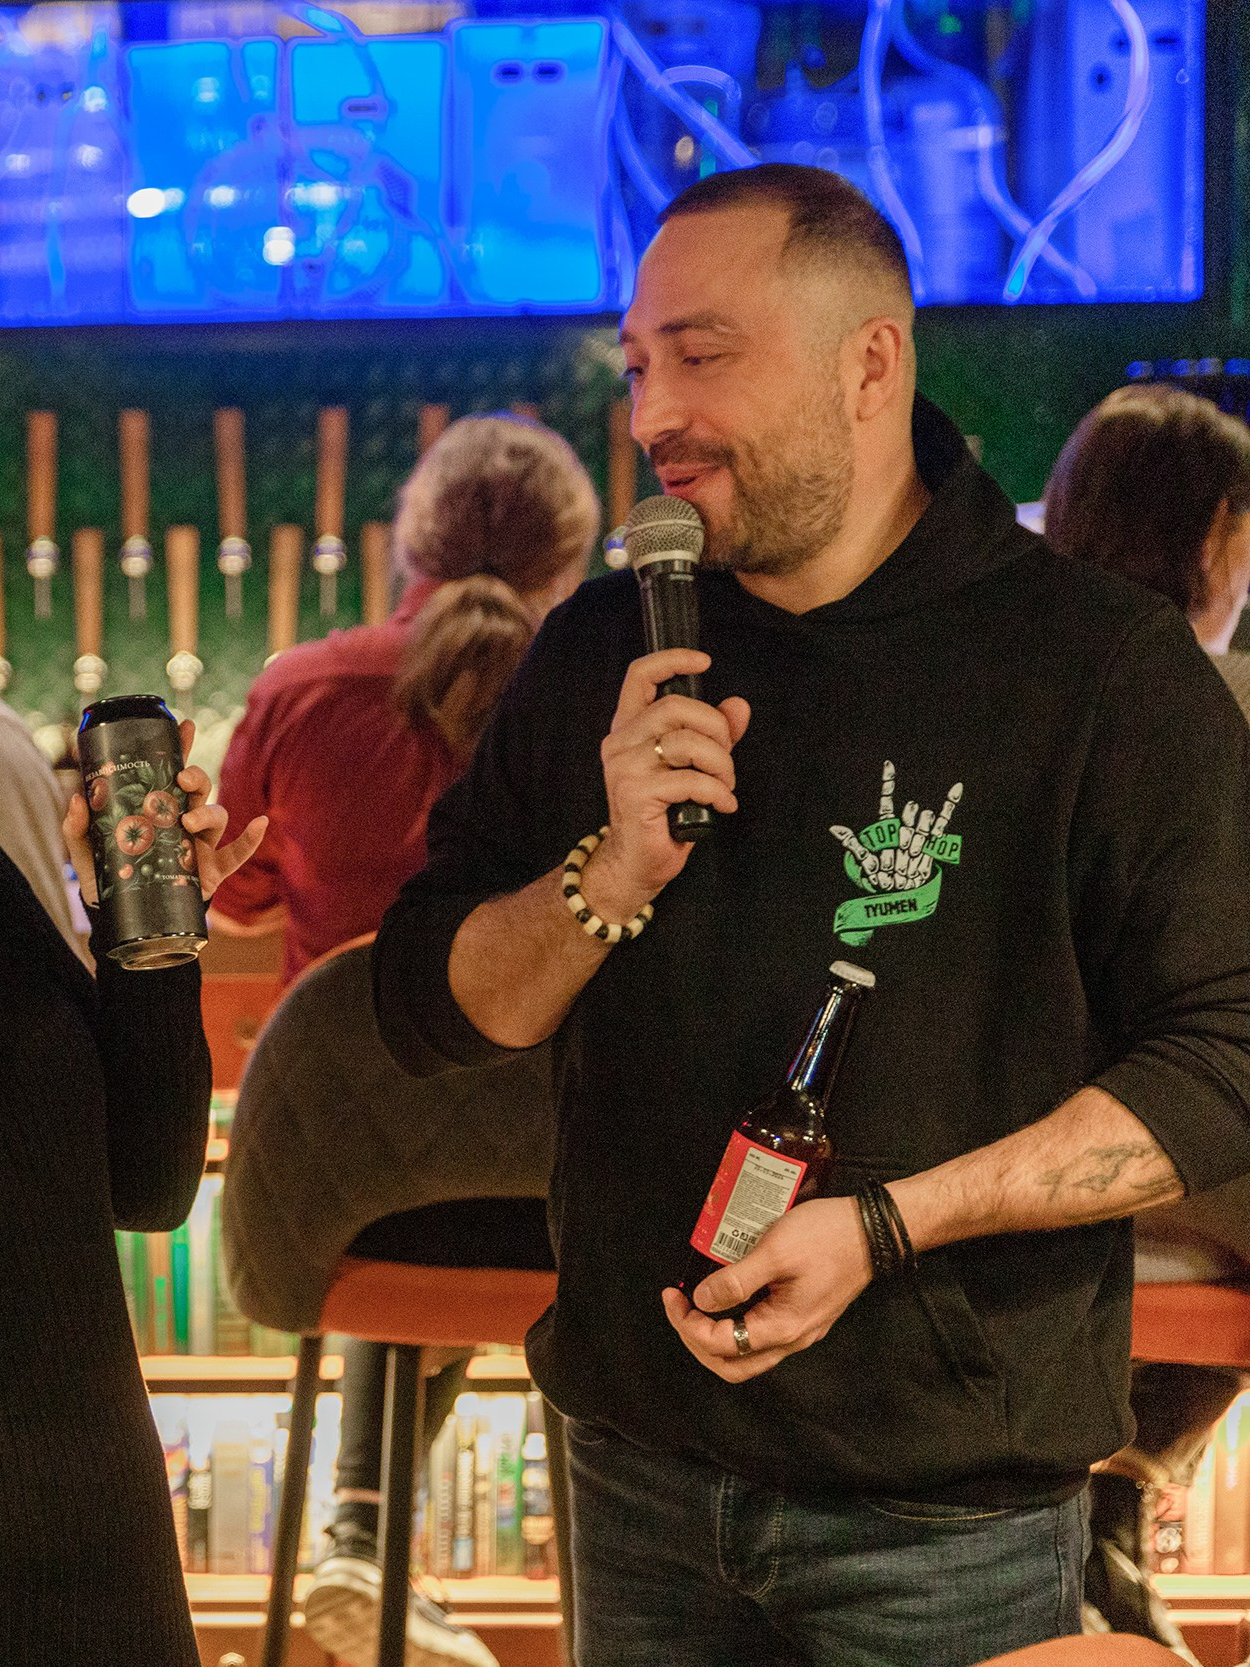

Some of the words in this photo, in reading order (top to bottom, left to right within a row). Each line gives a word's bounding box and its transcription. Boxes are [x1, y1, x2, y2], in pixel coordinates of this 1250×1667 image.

[864, 823, 897, 847] TOP
[927, 836, 958, 857] HOP
[864, 898, 917, 918] TYUMEN
